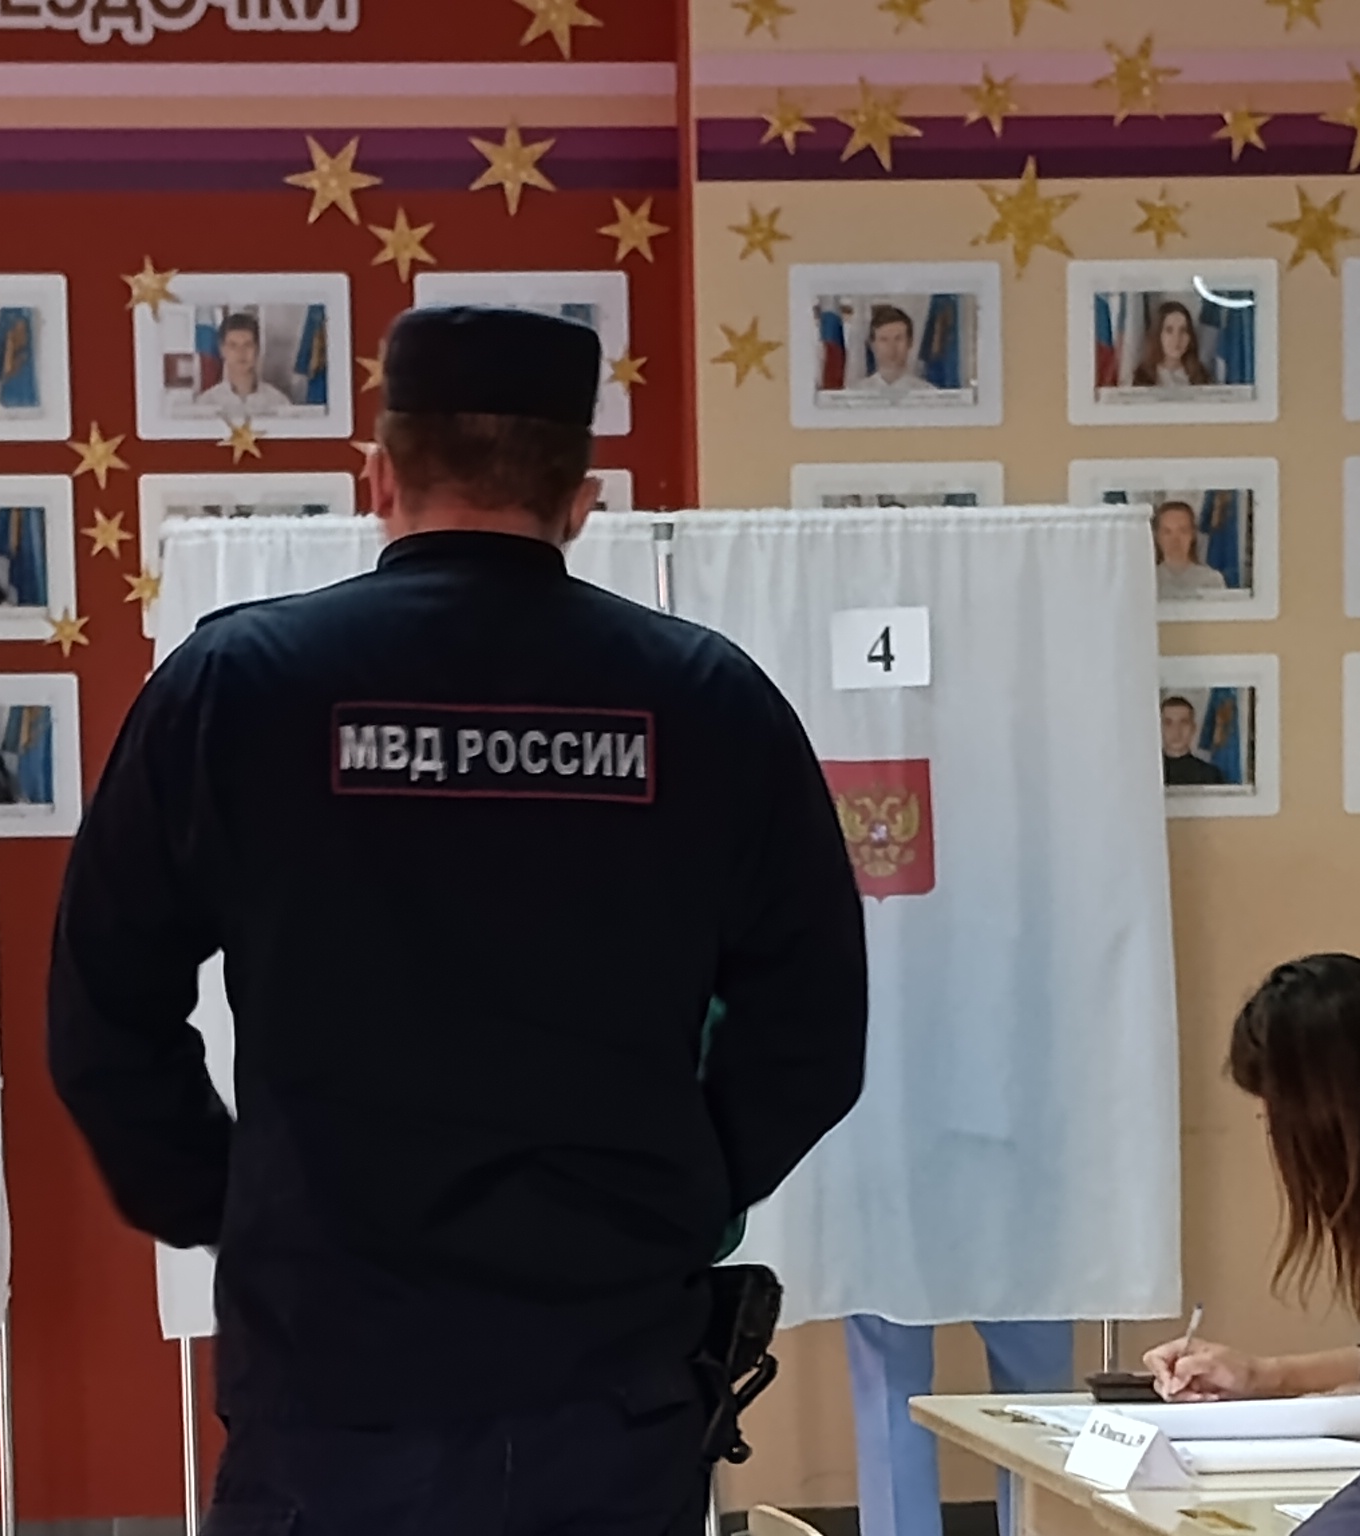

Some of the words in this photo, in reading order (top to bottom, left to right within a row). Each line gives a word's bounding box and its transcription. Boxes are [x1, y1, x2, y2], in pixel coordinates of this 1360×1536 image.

[867, 626, 895, 672] 4
[339, 725, 447, 781] МВД
[457, 729, 647, 779] РОССИИ
